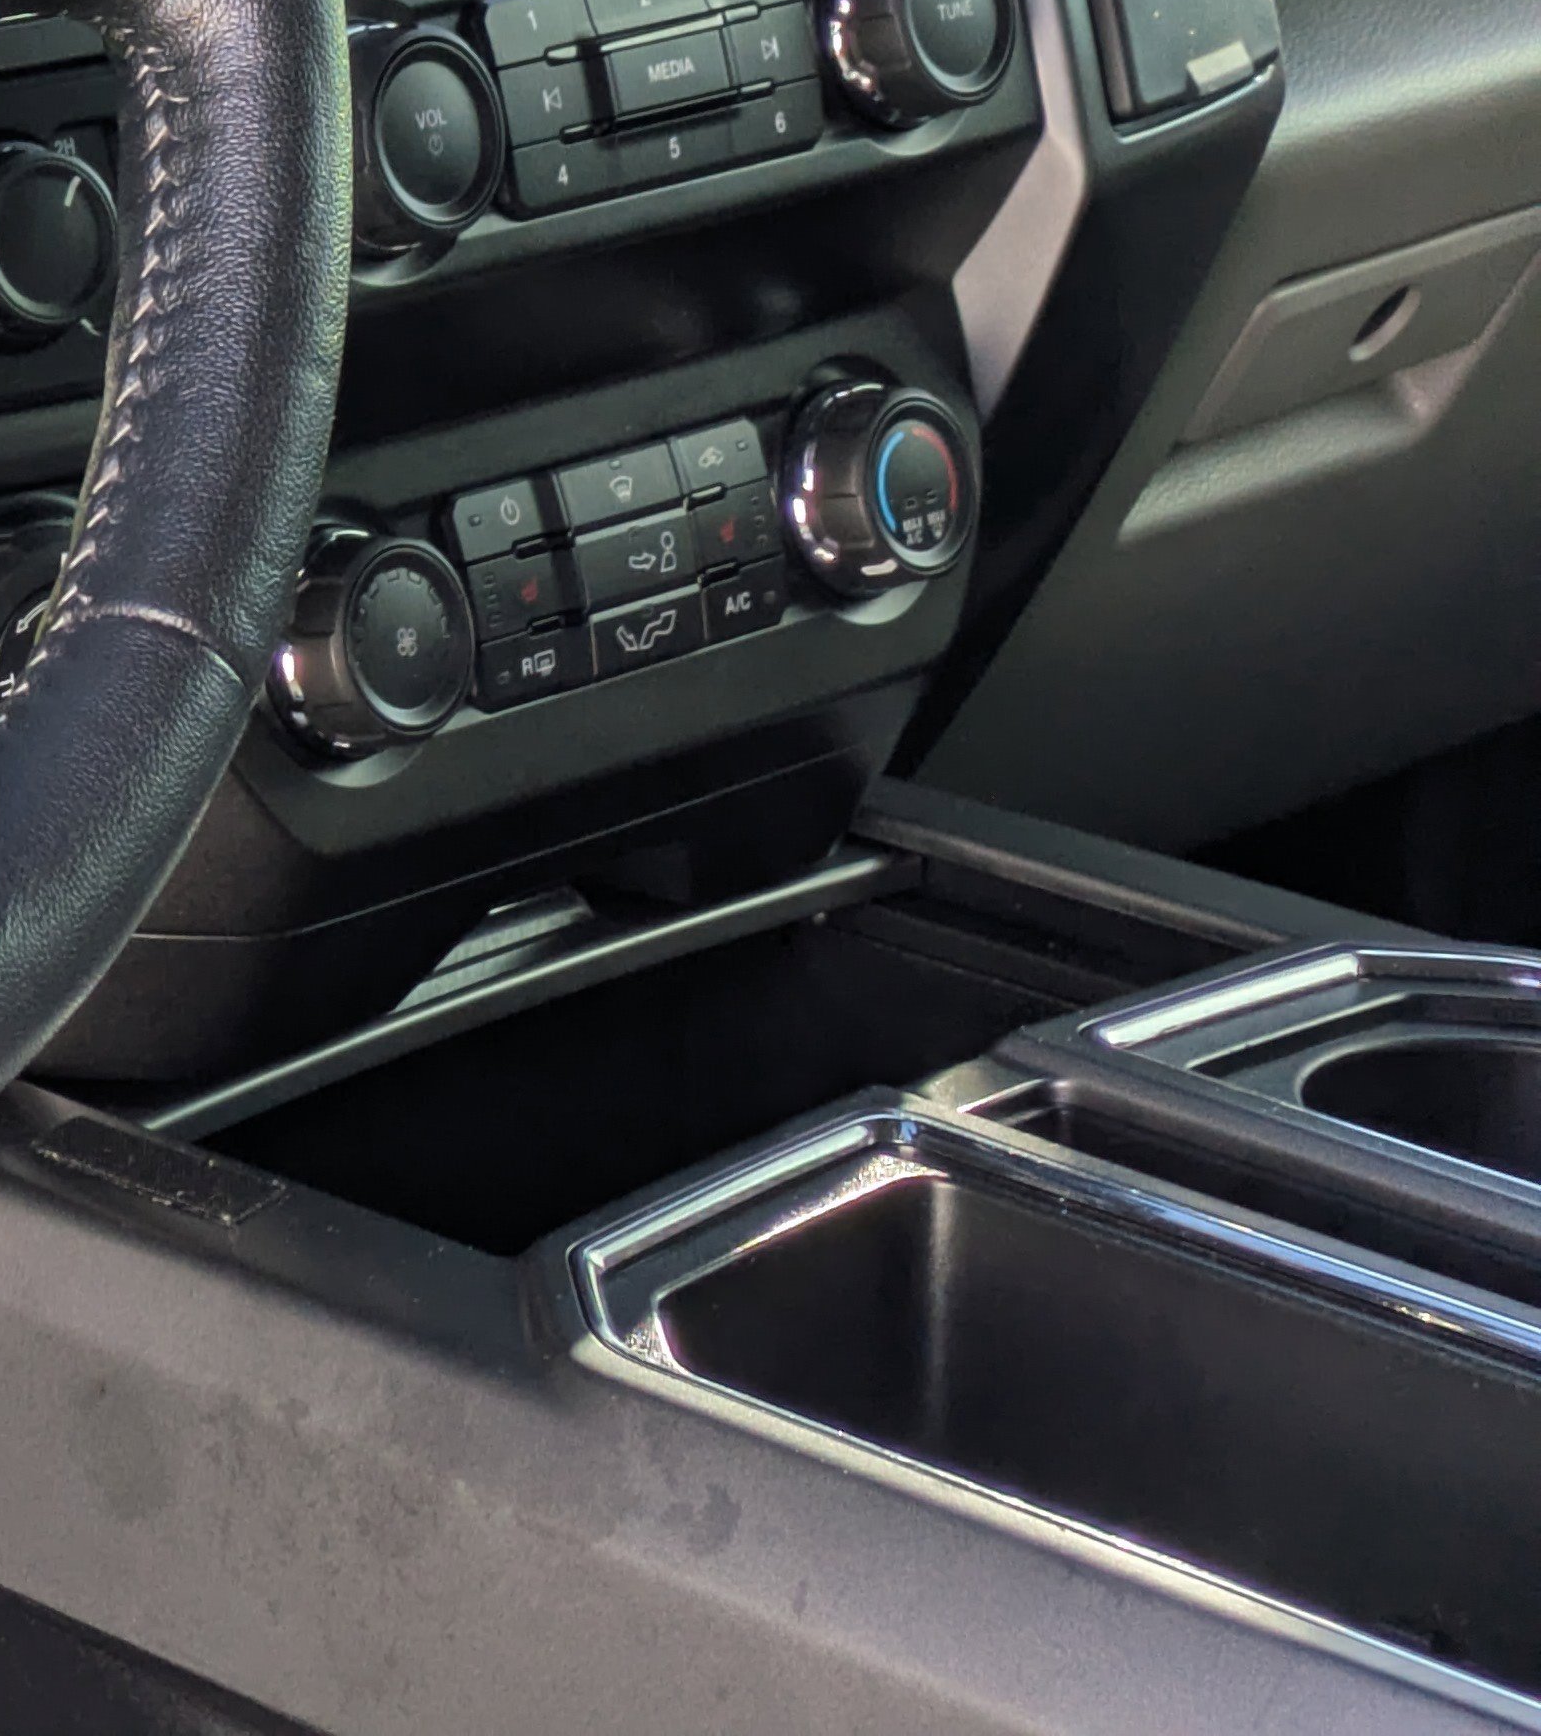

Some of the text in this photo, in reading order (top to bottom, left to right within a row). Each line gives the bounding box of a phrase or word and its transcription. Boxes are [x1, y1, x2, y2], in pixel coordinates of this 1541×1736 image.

[527, 10, 537, 31] 1
[937, 0, 974, 21] TUNE
[647, 56, 696, 82] MEDIA
[415, 108, 447, 129] VOL
[775, 111, 787, 134] 6
[669, 137, 681, 158] 5
[557, 165, 569, 186] 4
[725, 591, 752, 615] A/C
